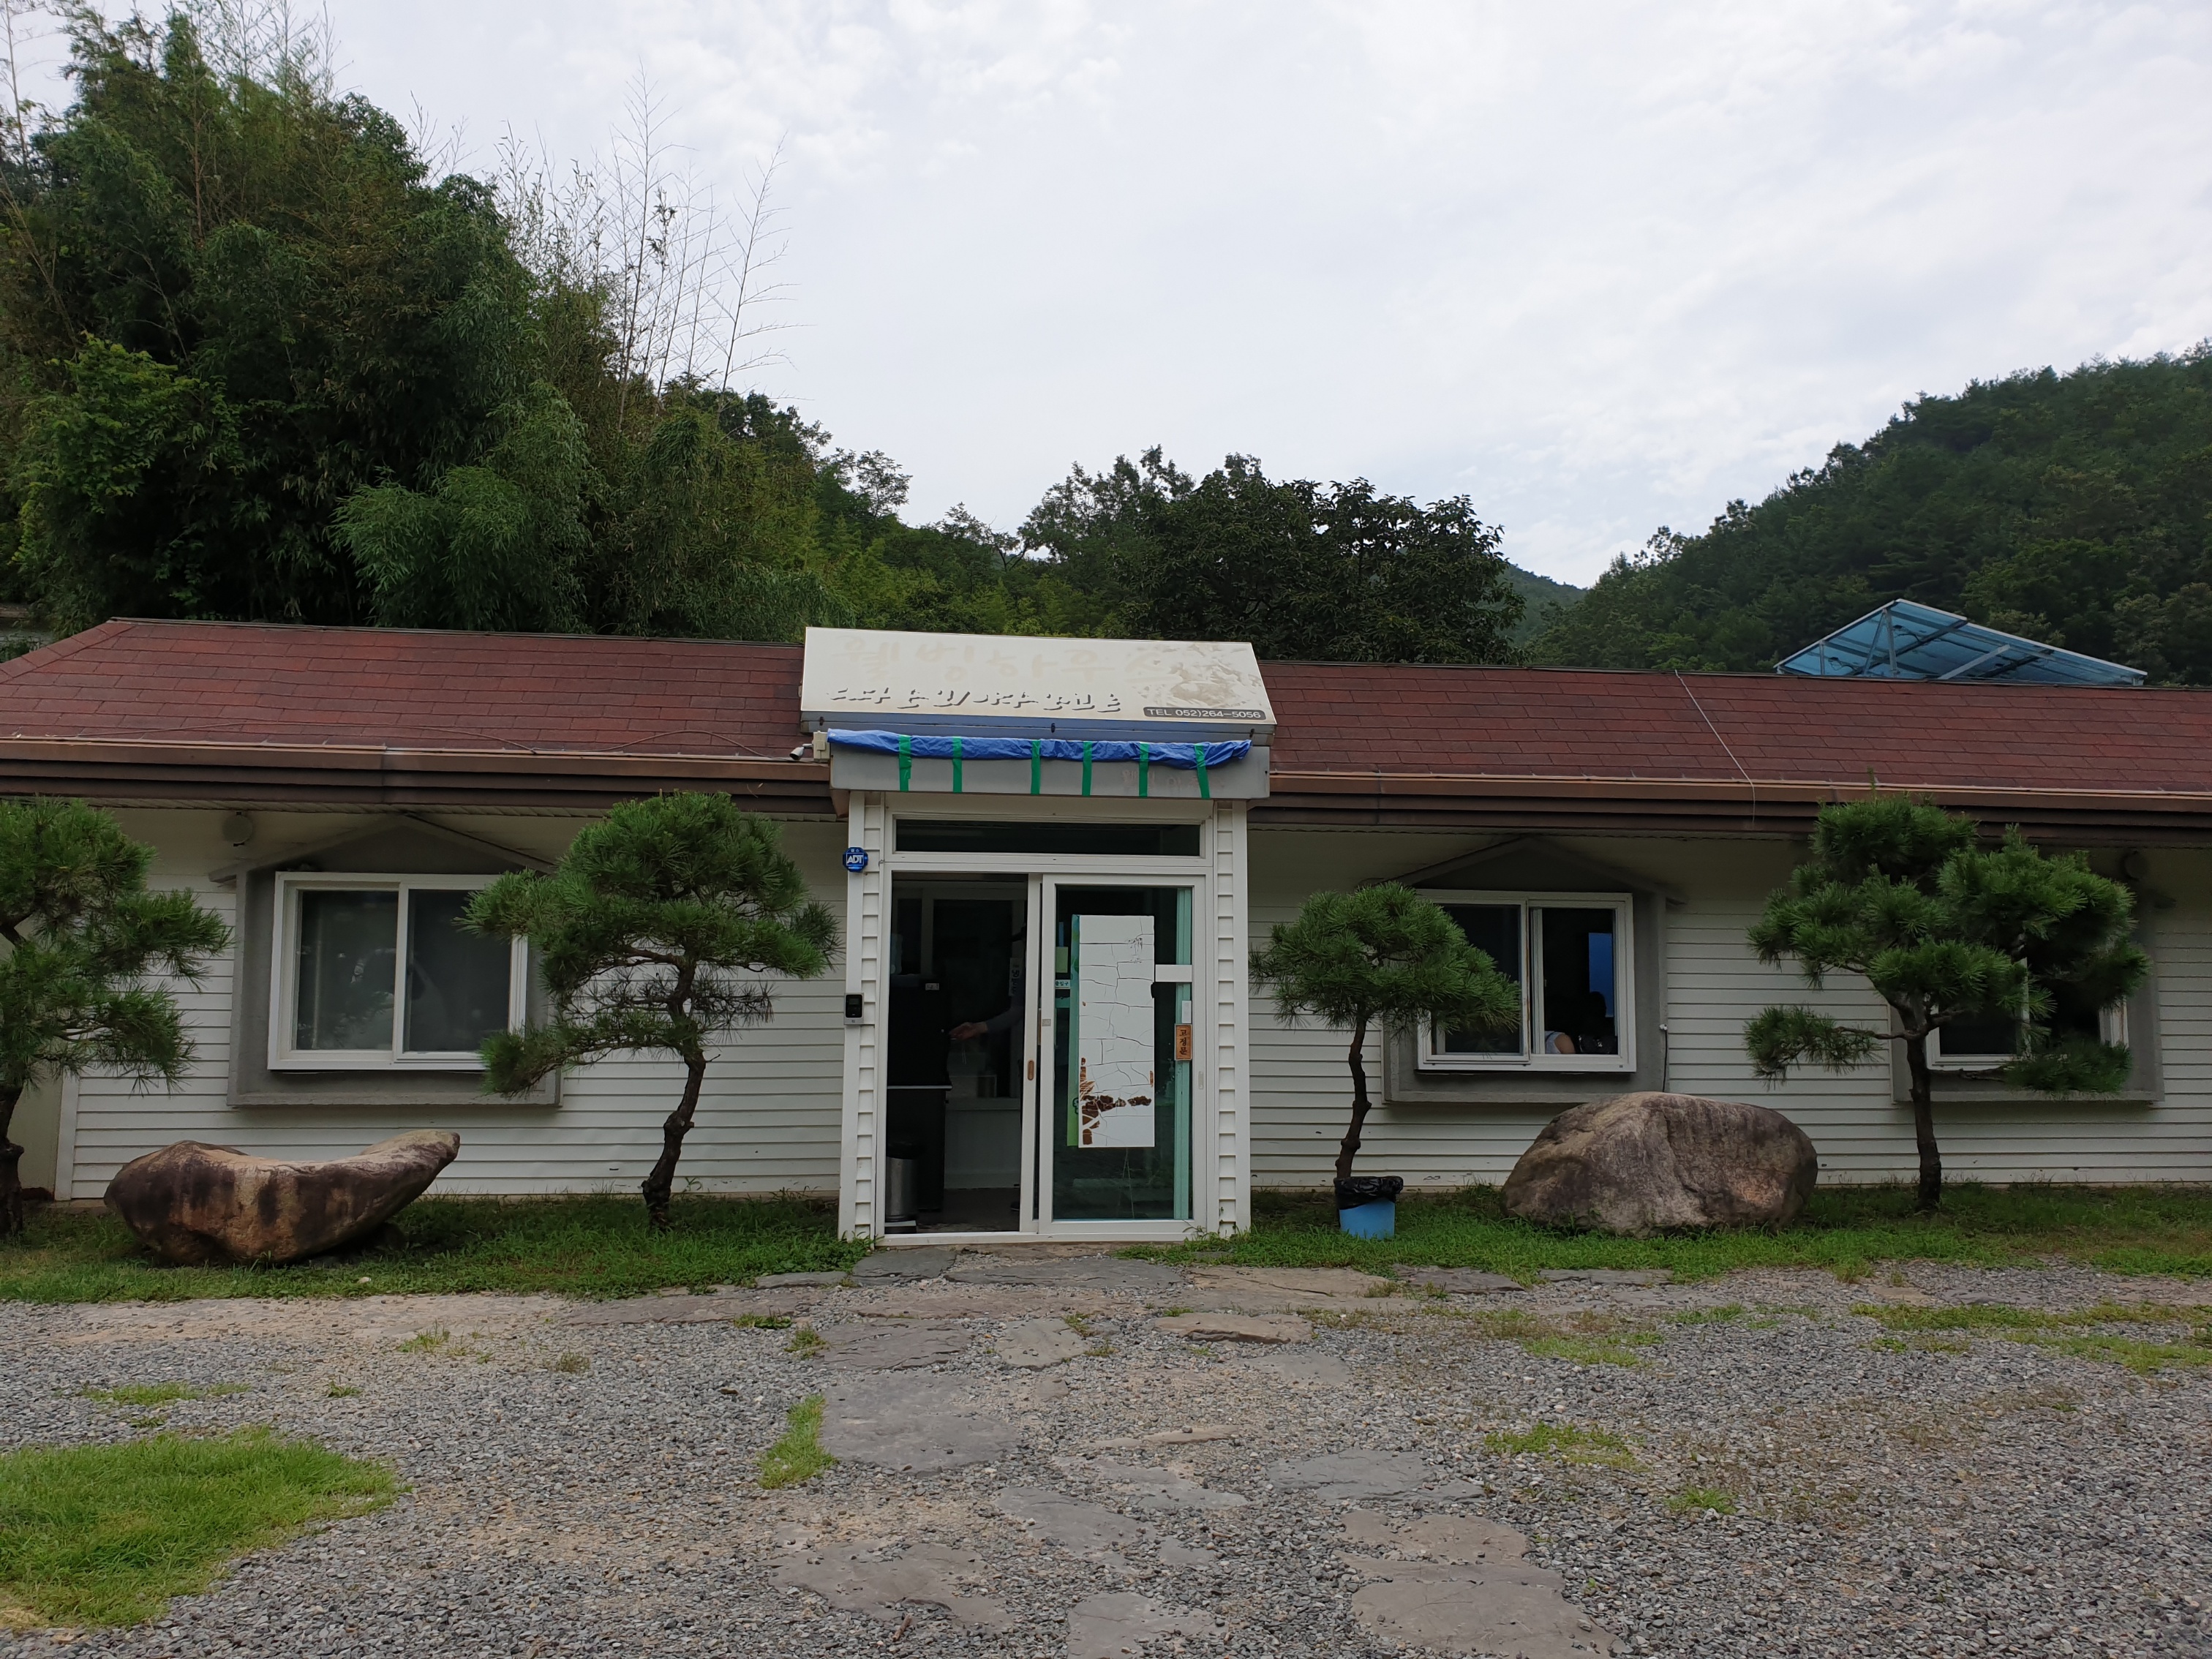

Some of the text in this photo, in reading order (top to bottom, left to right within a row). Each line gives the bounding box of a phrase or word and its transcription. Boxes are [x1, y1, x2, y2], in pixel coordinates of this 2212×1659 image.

[1147, 708, 1261, 718] TEL 052)264-5056
[846, 855, 864, 863] ADT
[1179, 1029, 1188, 1055] 고정문
